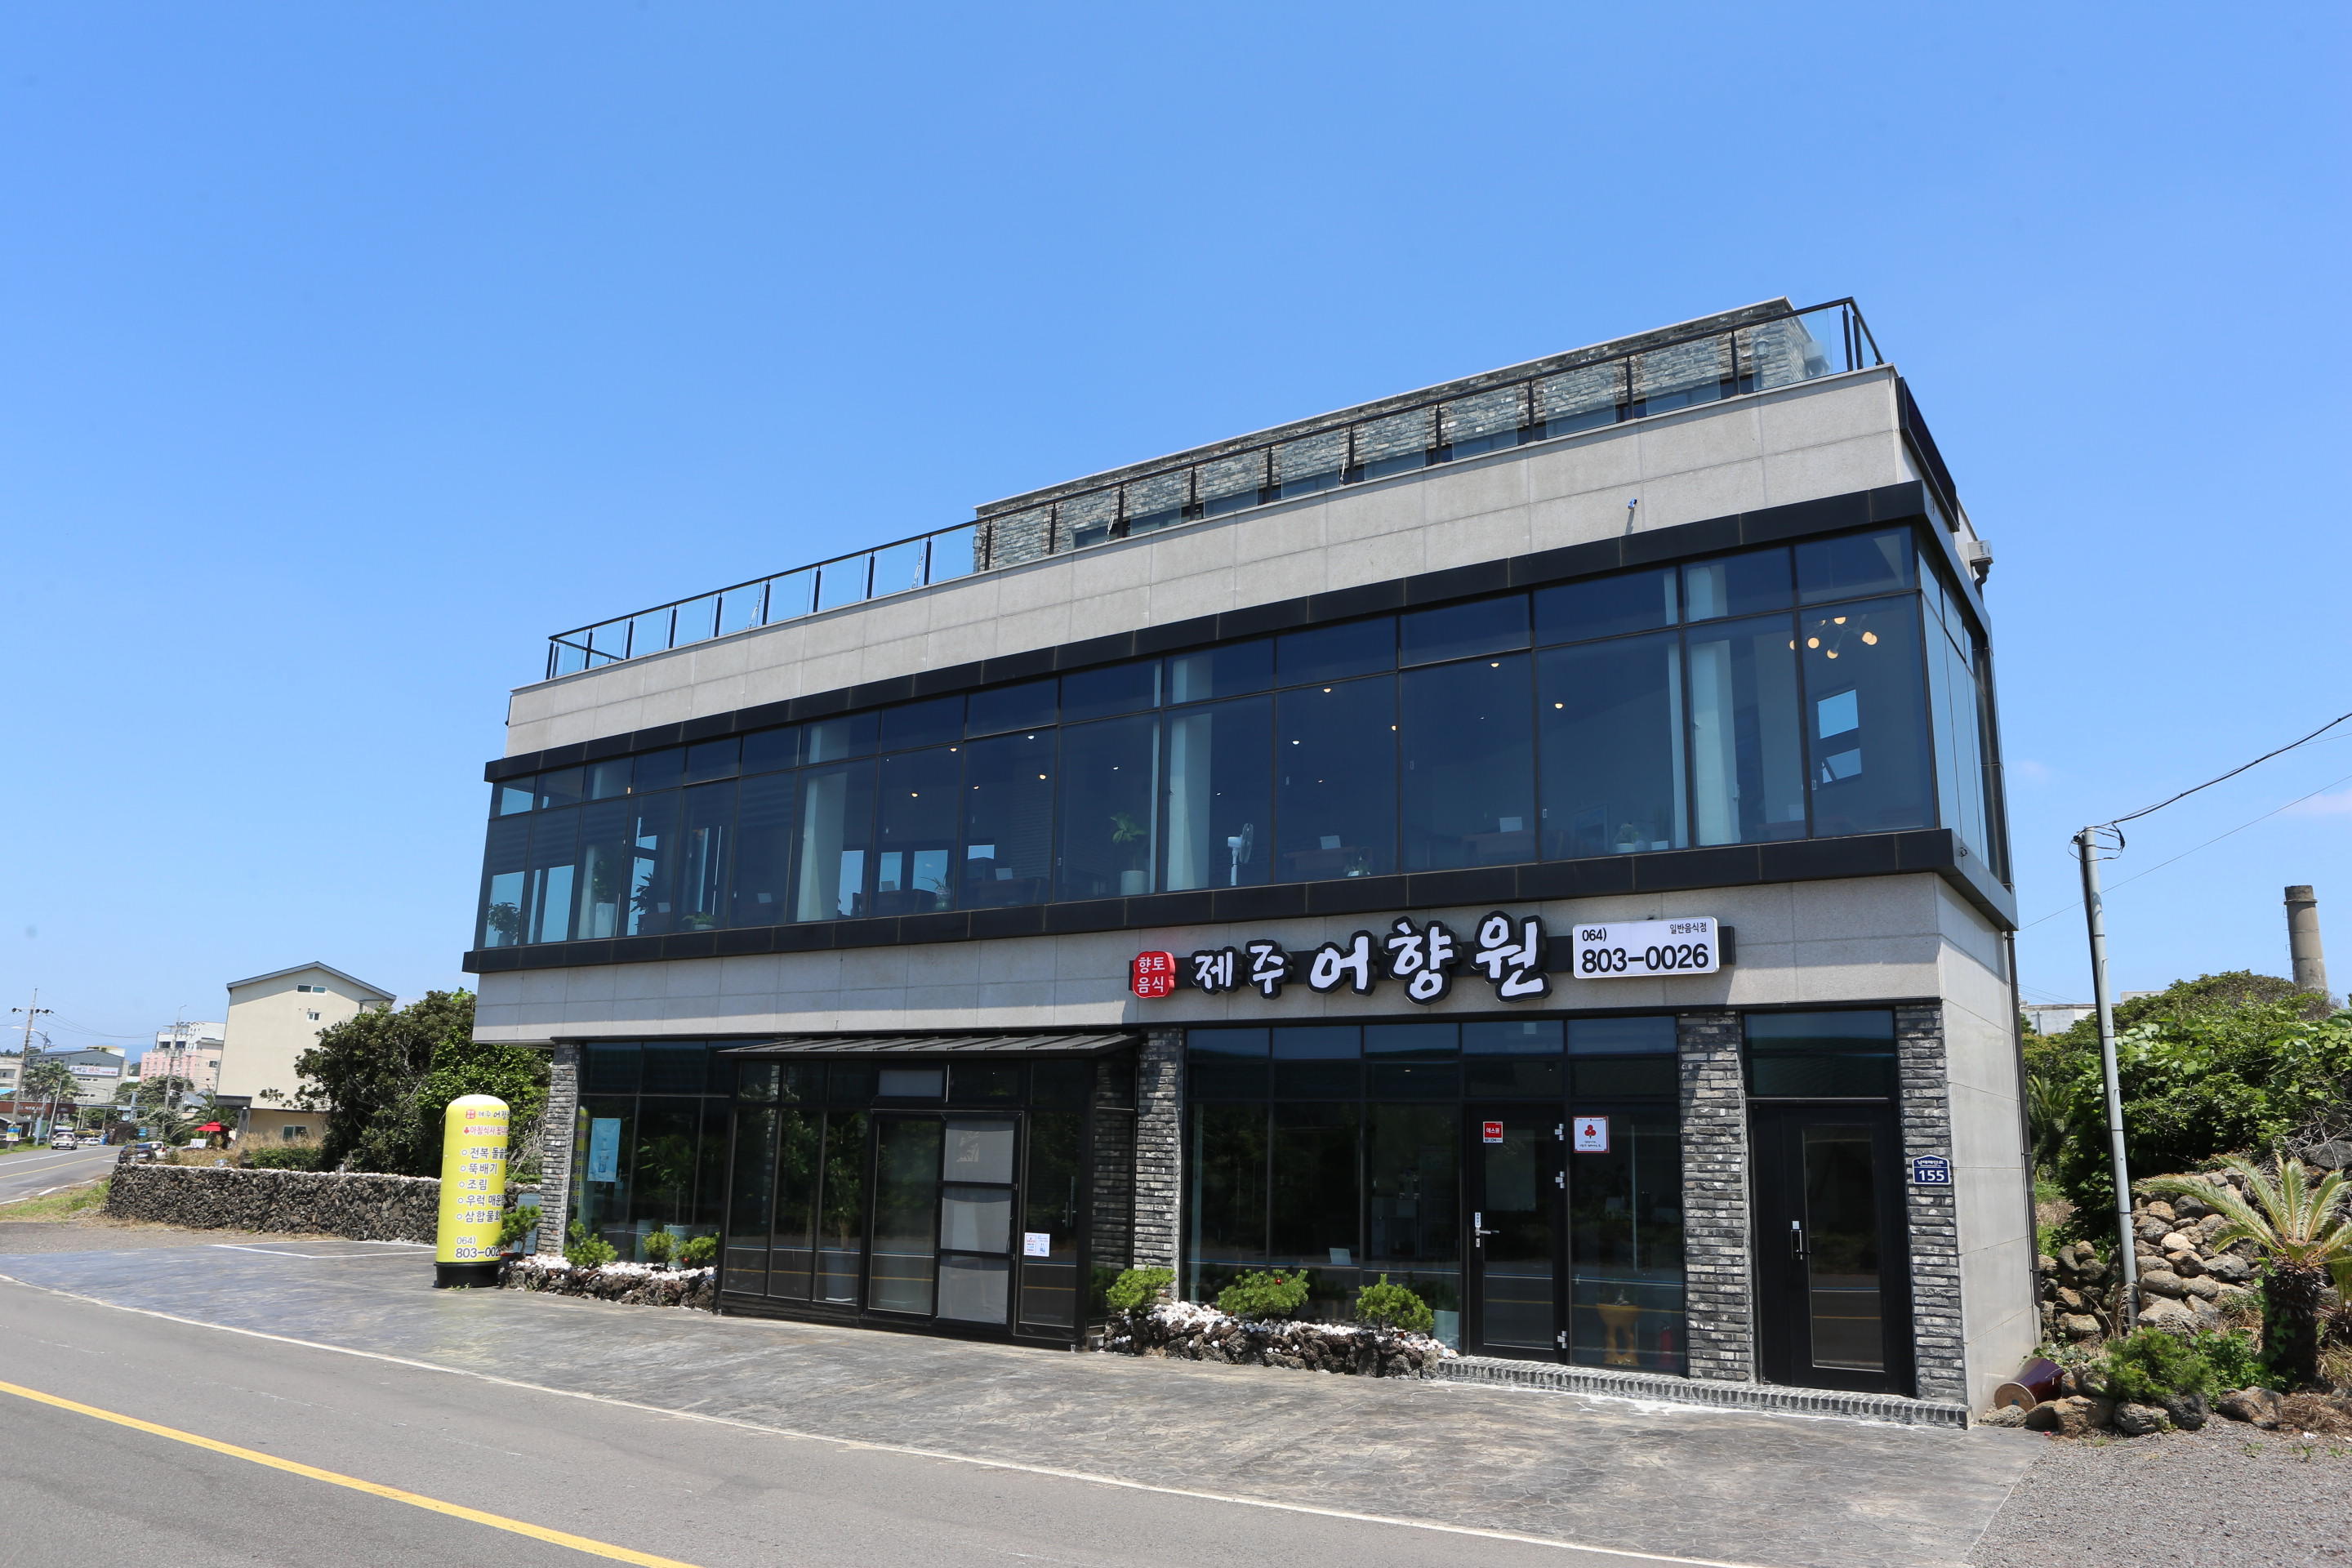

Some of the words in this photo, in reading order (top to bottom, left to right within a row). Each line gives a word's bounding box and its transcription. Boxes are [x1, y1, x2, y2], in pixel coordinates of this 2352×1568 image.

[1669, 922, 1707, 934] 일반음식점
[1582, 927, 1607, 942] 064)
[1195, 945, 1285, 994] 제주
[1310, 916, 1544, 1000] 어향원
[1581, 943, 1709, 973] 803-0026
[1138, 956, 1165, 974] 향토
[1137, 976, 1165, 994] 음식
[470, 1126, 495, 1135] 아침식사
[470, 1147, 489, 1159] 전복
[469, 1163, 497, 1175] 뚝배기
[1919, 1169, 1945, 1182] 155
[467, 1179, 488, 1191] 조림
[466, 1195, 485, 1206] 우럭
[457, 1236, 476, 1245] 064)
[456, 1246, 501, 1258] 803-002
